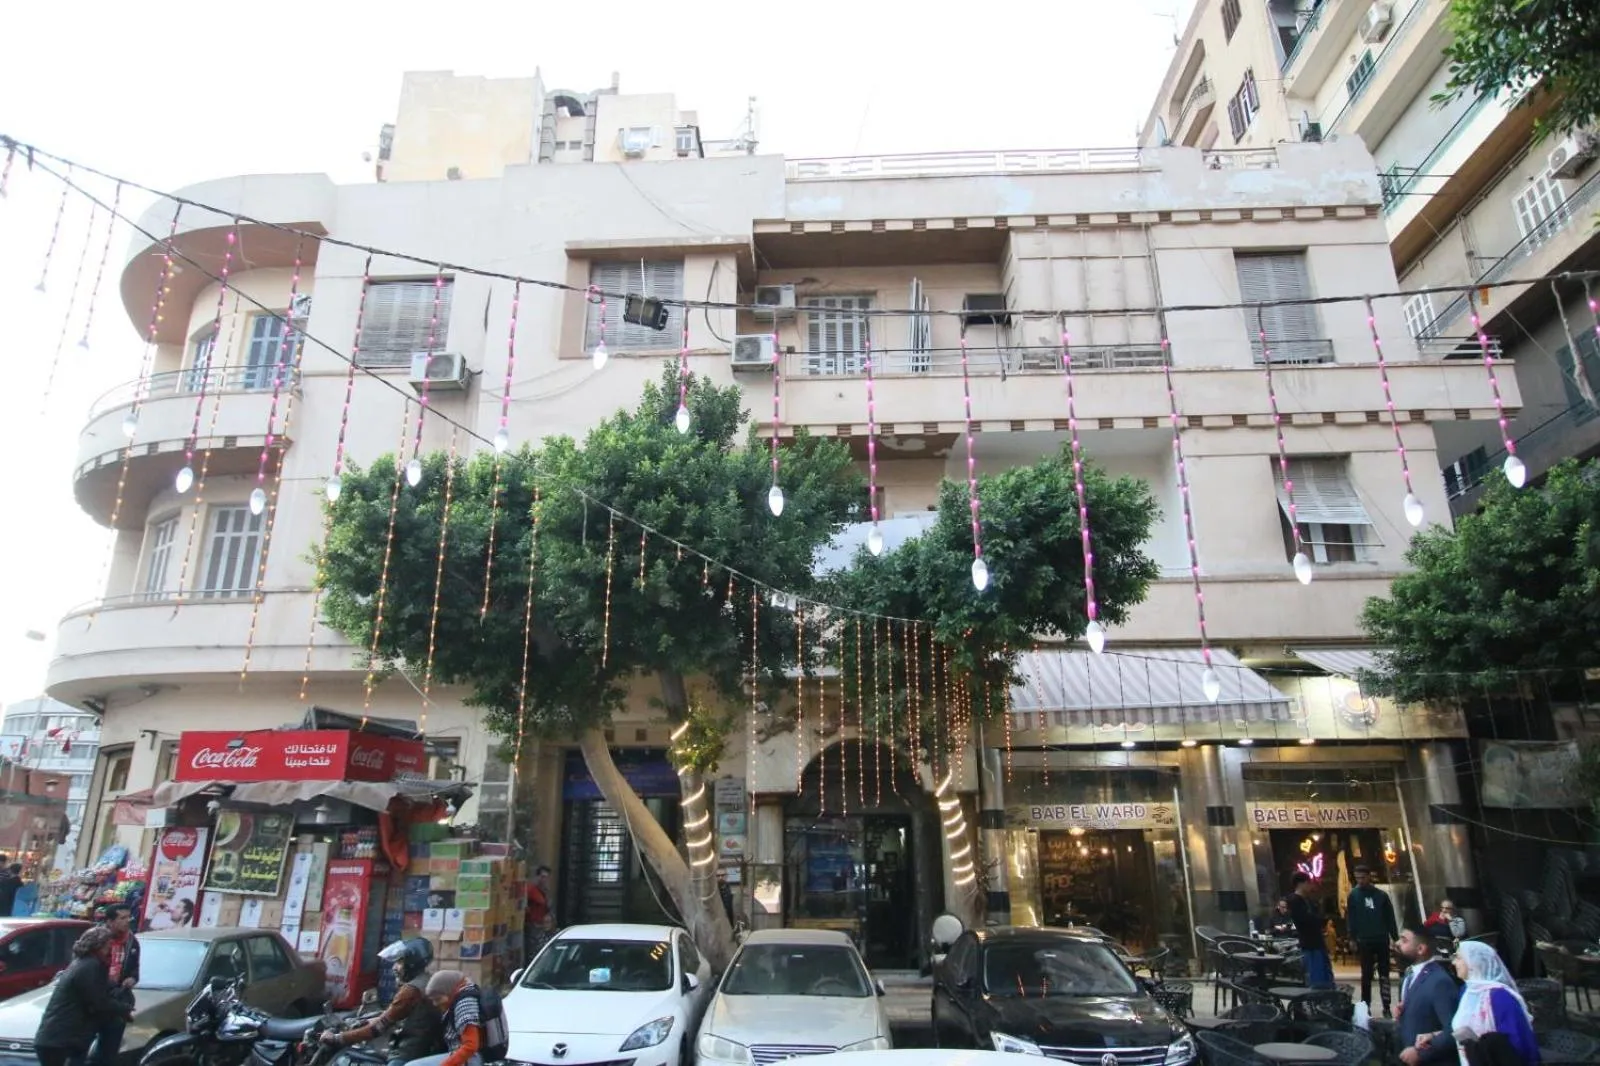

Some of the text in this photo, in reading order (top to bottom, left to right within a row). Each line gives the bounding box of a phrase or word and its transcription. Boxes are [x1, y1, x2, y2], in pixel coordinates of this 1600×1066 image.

[192, 747, 262, 769] Coca-Cola
[1031, 806, 1066, 820] BAB
[1070, 805, 1092, 819] EL
[1096, 804, 1146, 819] WARD
[1253, 808, 1370, 823] BAB EL WARD
